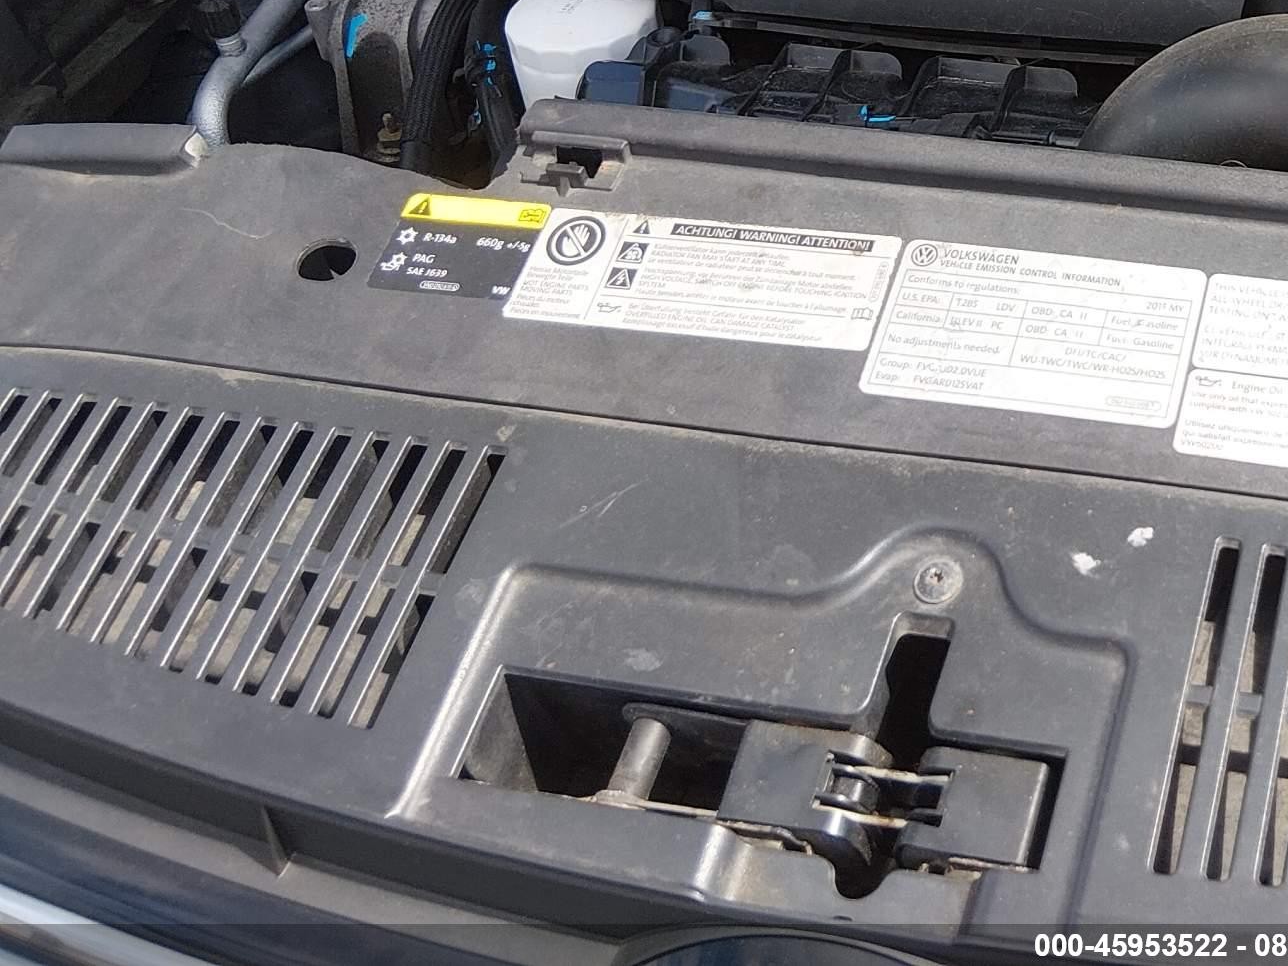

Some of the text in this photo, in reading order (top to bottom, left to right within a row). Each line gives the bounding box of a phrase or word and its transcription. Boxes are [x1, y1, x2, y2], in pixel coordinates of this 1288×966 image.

[422, 234, 531, 253] R-134a 660g +/-5g
[675, 225, 870, 250] ACHTUNG! WARNING! ATTENTION!
[412, 253, 436, 264] PAG
[943, 249, 1020, 265] VOLKSWAGEN
[406, 267, 448, 278] SAE J639
[940, 259, 1121, 287] VEHICLE EMISSION CONTROL INFORMATION
[907, 274, 952, 287] Conforms
[954, 280, 964, 288] to
[491, 286, 512, 295] VW
[995, 302, 1016, 312] LDV
[1059, 309, 1073, 319] CA
[991, 321, 1005, 330] PC
[1054, 327, 1067, 337] CA
[888, 332, 900, 342] No
[903, 336, 961, 350] adjustments
[1133, 337, 1175, 350] Gasoline
[879, 357, 912, 370] Group:
[1231, 380, 1265, 394] Engine
